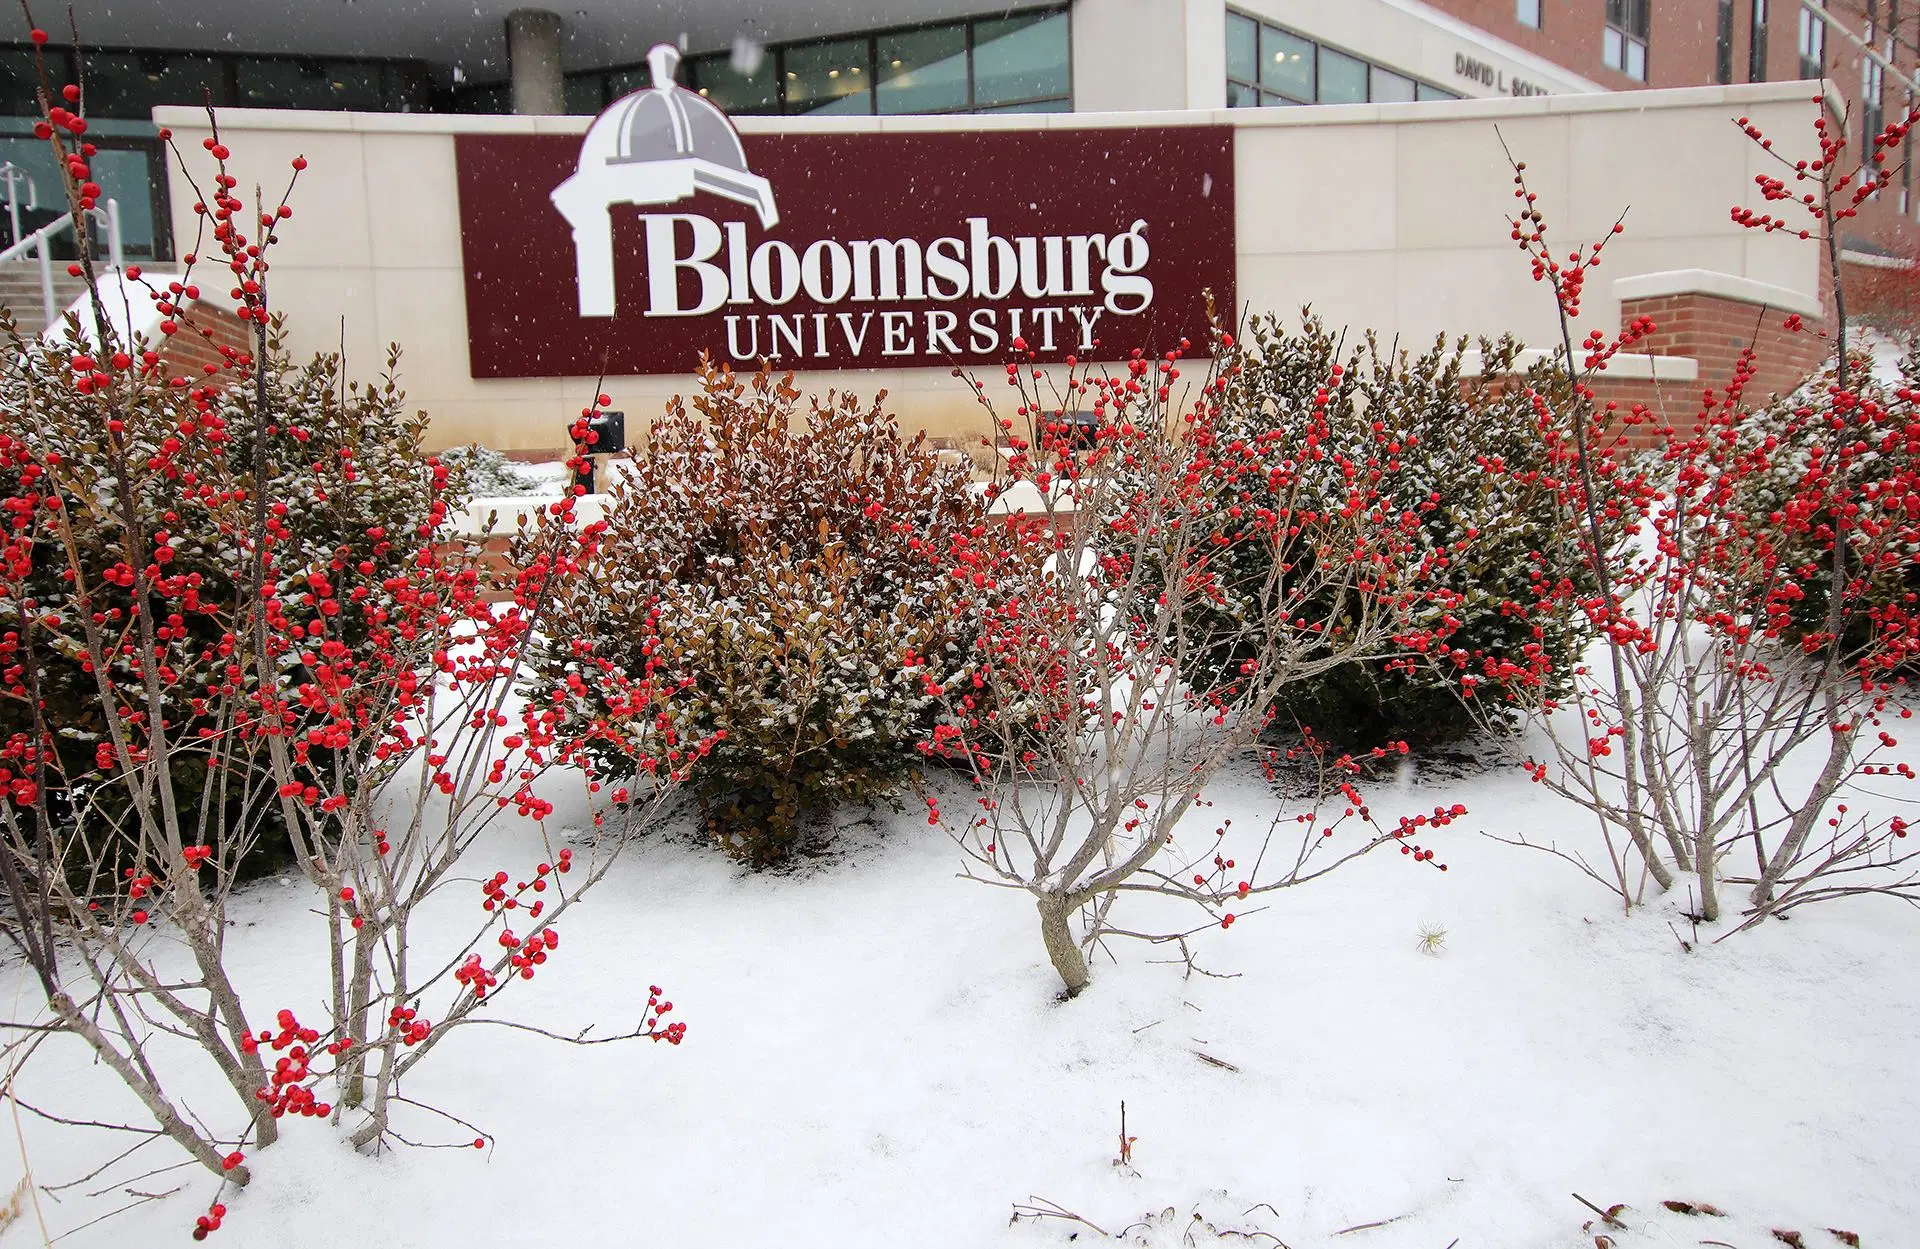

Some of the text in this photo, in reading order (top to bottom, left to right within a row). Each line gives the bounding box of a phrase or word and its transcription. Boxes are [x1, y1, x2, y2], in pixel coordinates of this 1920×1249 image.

[1455, 51, 1494, 87] DAVID
[638, 213, 1154, 316] Bloomsburg
[723, 305, 1106, 360] UNIVERSITY
